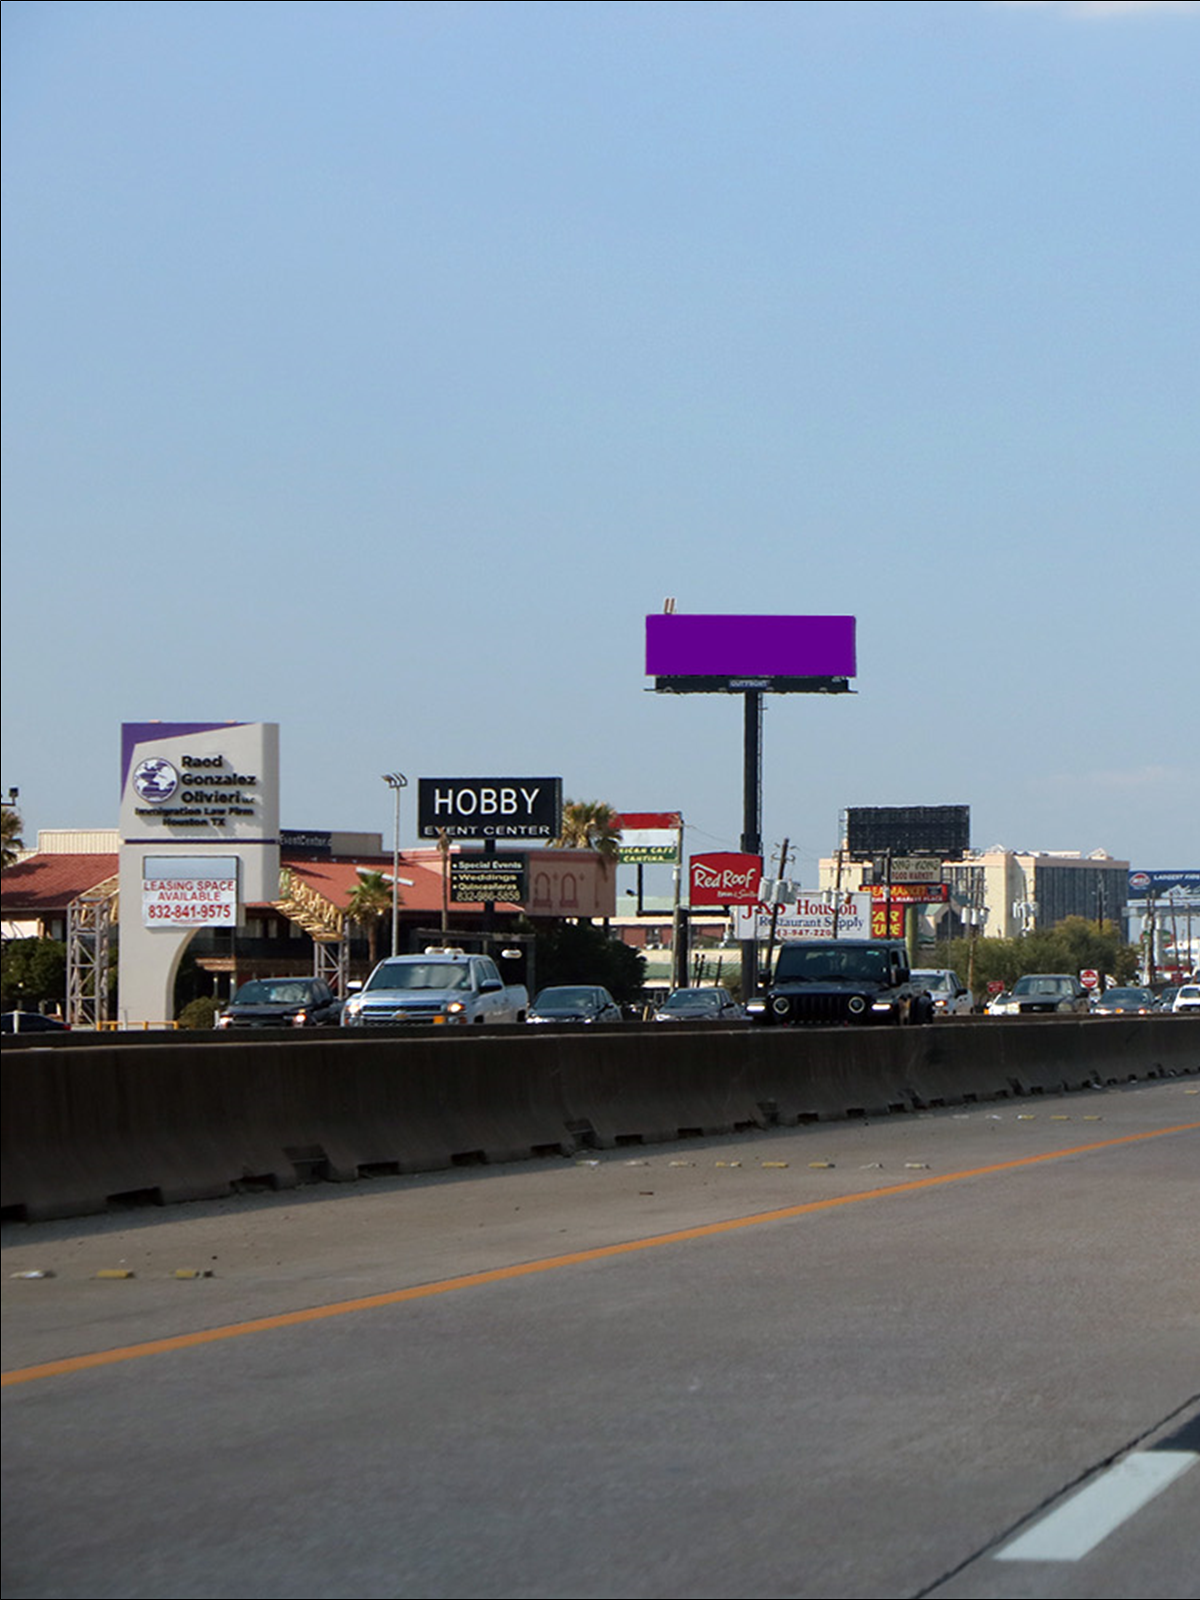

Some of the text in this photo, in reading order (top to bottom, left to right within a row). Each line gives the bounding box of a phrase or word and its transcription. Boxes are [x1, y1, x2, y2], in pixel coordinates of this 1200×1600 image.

[181, 755, 223, 768] Raed
[181, 773, 257, 786] Gonzalez
[181, 790, 241, 803] Olivieri
[433, 787, 540, 815] HOBBY
[135, 807, 255, 817] Immigration Law Firm
[162, 818, 226, 827] Houston TX
[483, 825, 551, 836] CENTER
[458, 860, 522, 870] Special Events
[458, 874, 517, 882] Weddings
[694, 868, 756, 889] Red Roof
[143, 880, 235, 891] LEASING SPACE
[158, 892, 221, 901] AVAILABLE
[147, 904, 231, 919] 832-841-9575
[797, 899, 857, 916] Houson
[759, 915, 864, 931] Retaurant Spply
